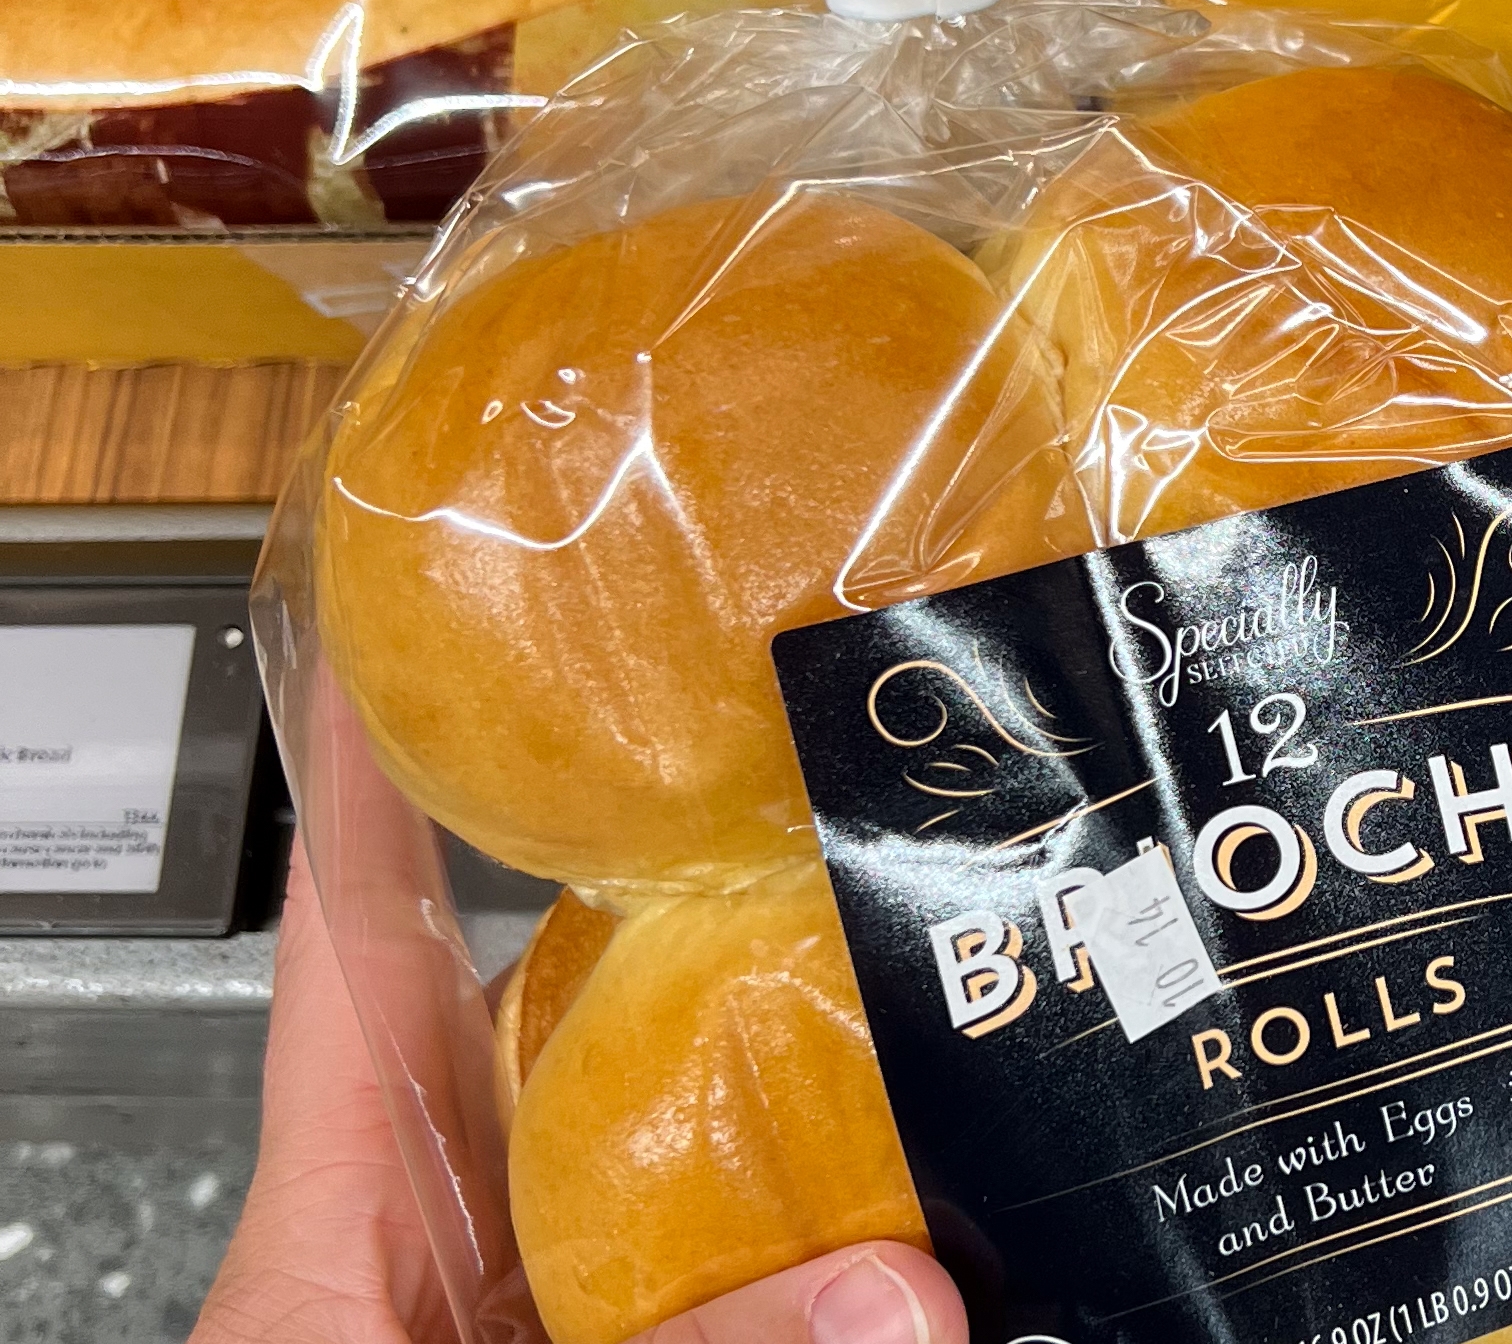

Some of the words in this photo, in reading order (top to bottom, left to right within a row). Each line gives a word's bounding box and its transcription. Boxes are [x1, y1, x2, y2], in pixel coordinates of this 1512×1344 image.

[1109, 555, 1350, 707] Specially
[1207, 690, 1321, 787] 12
[1191, 956, 1468, 1090] ROLLS
[1151, 1156, 1265, 1224] Made
[1278, 1120, 1367, 1176] with
[1379, 1095, 1475, 1145] Eggs
[1218, 1194, 1296, 1257] and
[1303, 1163, 1437, 1223] Butter
[1388, 1302, 1415, 1344] (1
[1416, 1291, 1450, 1330] LB
[1452, 1277, 1491, 1317] 0.9
